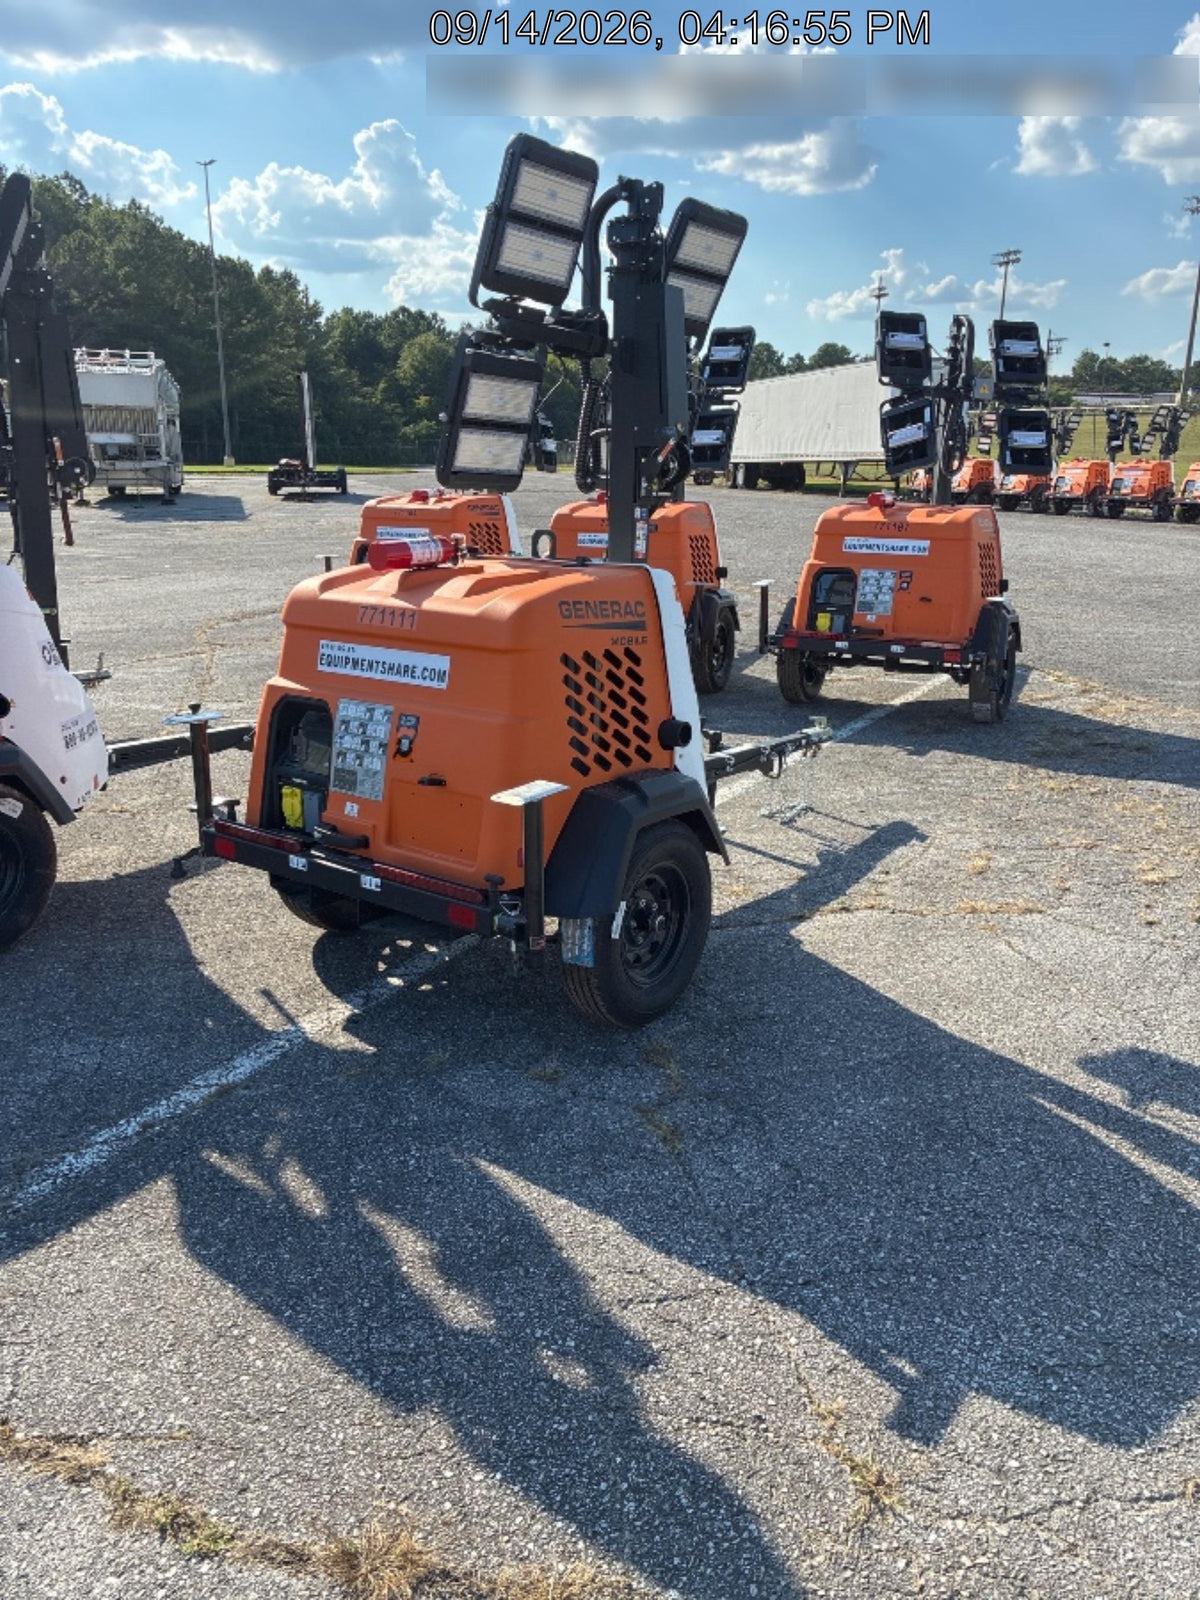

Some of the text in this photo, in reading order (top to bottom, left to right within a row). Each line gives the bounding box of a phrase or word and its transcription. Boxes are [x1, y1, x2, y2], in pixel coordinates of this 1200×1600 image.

[359, 604, 416, 629] 771111
[558, 600, 646, 619] GENERAC
[319, 653, 447, 684] EQUIPMENTSHARE.COM
